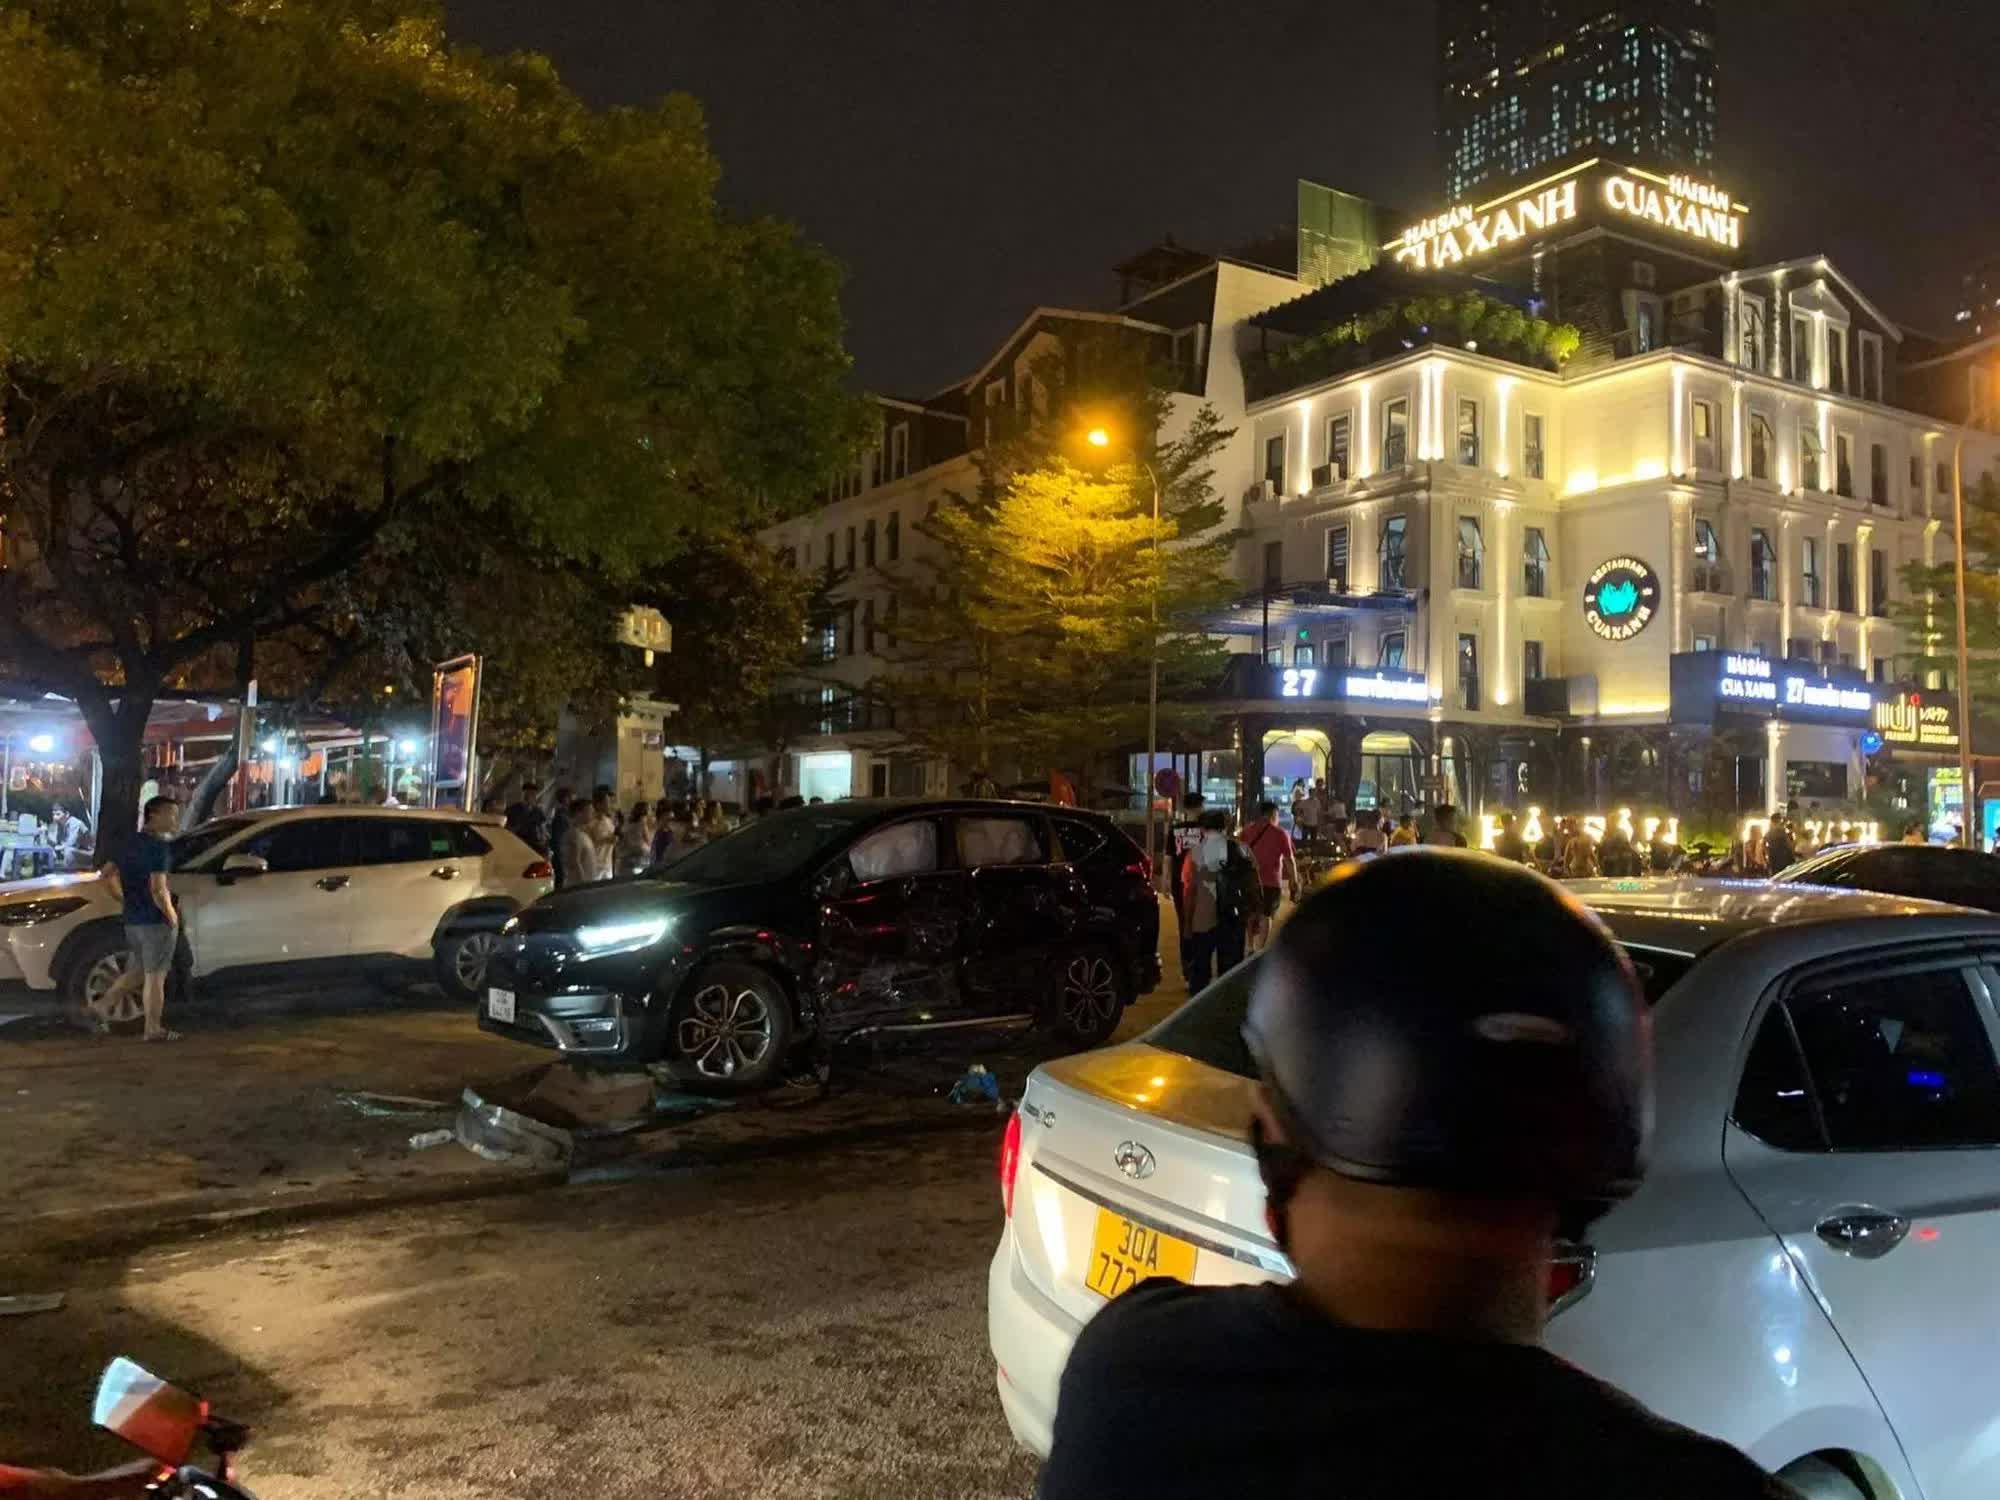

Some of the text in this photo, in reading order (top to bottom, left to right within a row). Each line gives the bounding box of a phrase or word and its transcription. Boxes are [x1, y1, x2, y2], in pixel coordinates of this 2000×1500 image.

[1464, 181, 1577, 257] XANH
[1282, 669, 1317, 697] 27
[1721, 678, 1744, 697] CUA
[1118, 1219, 1159, 1272] 30A
